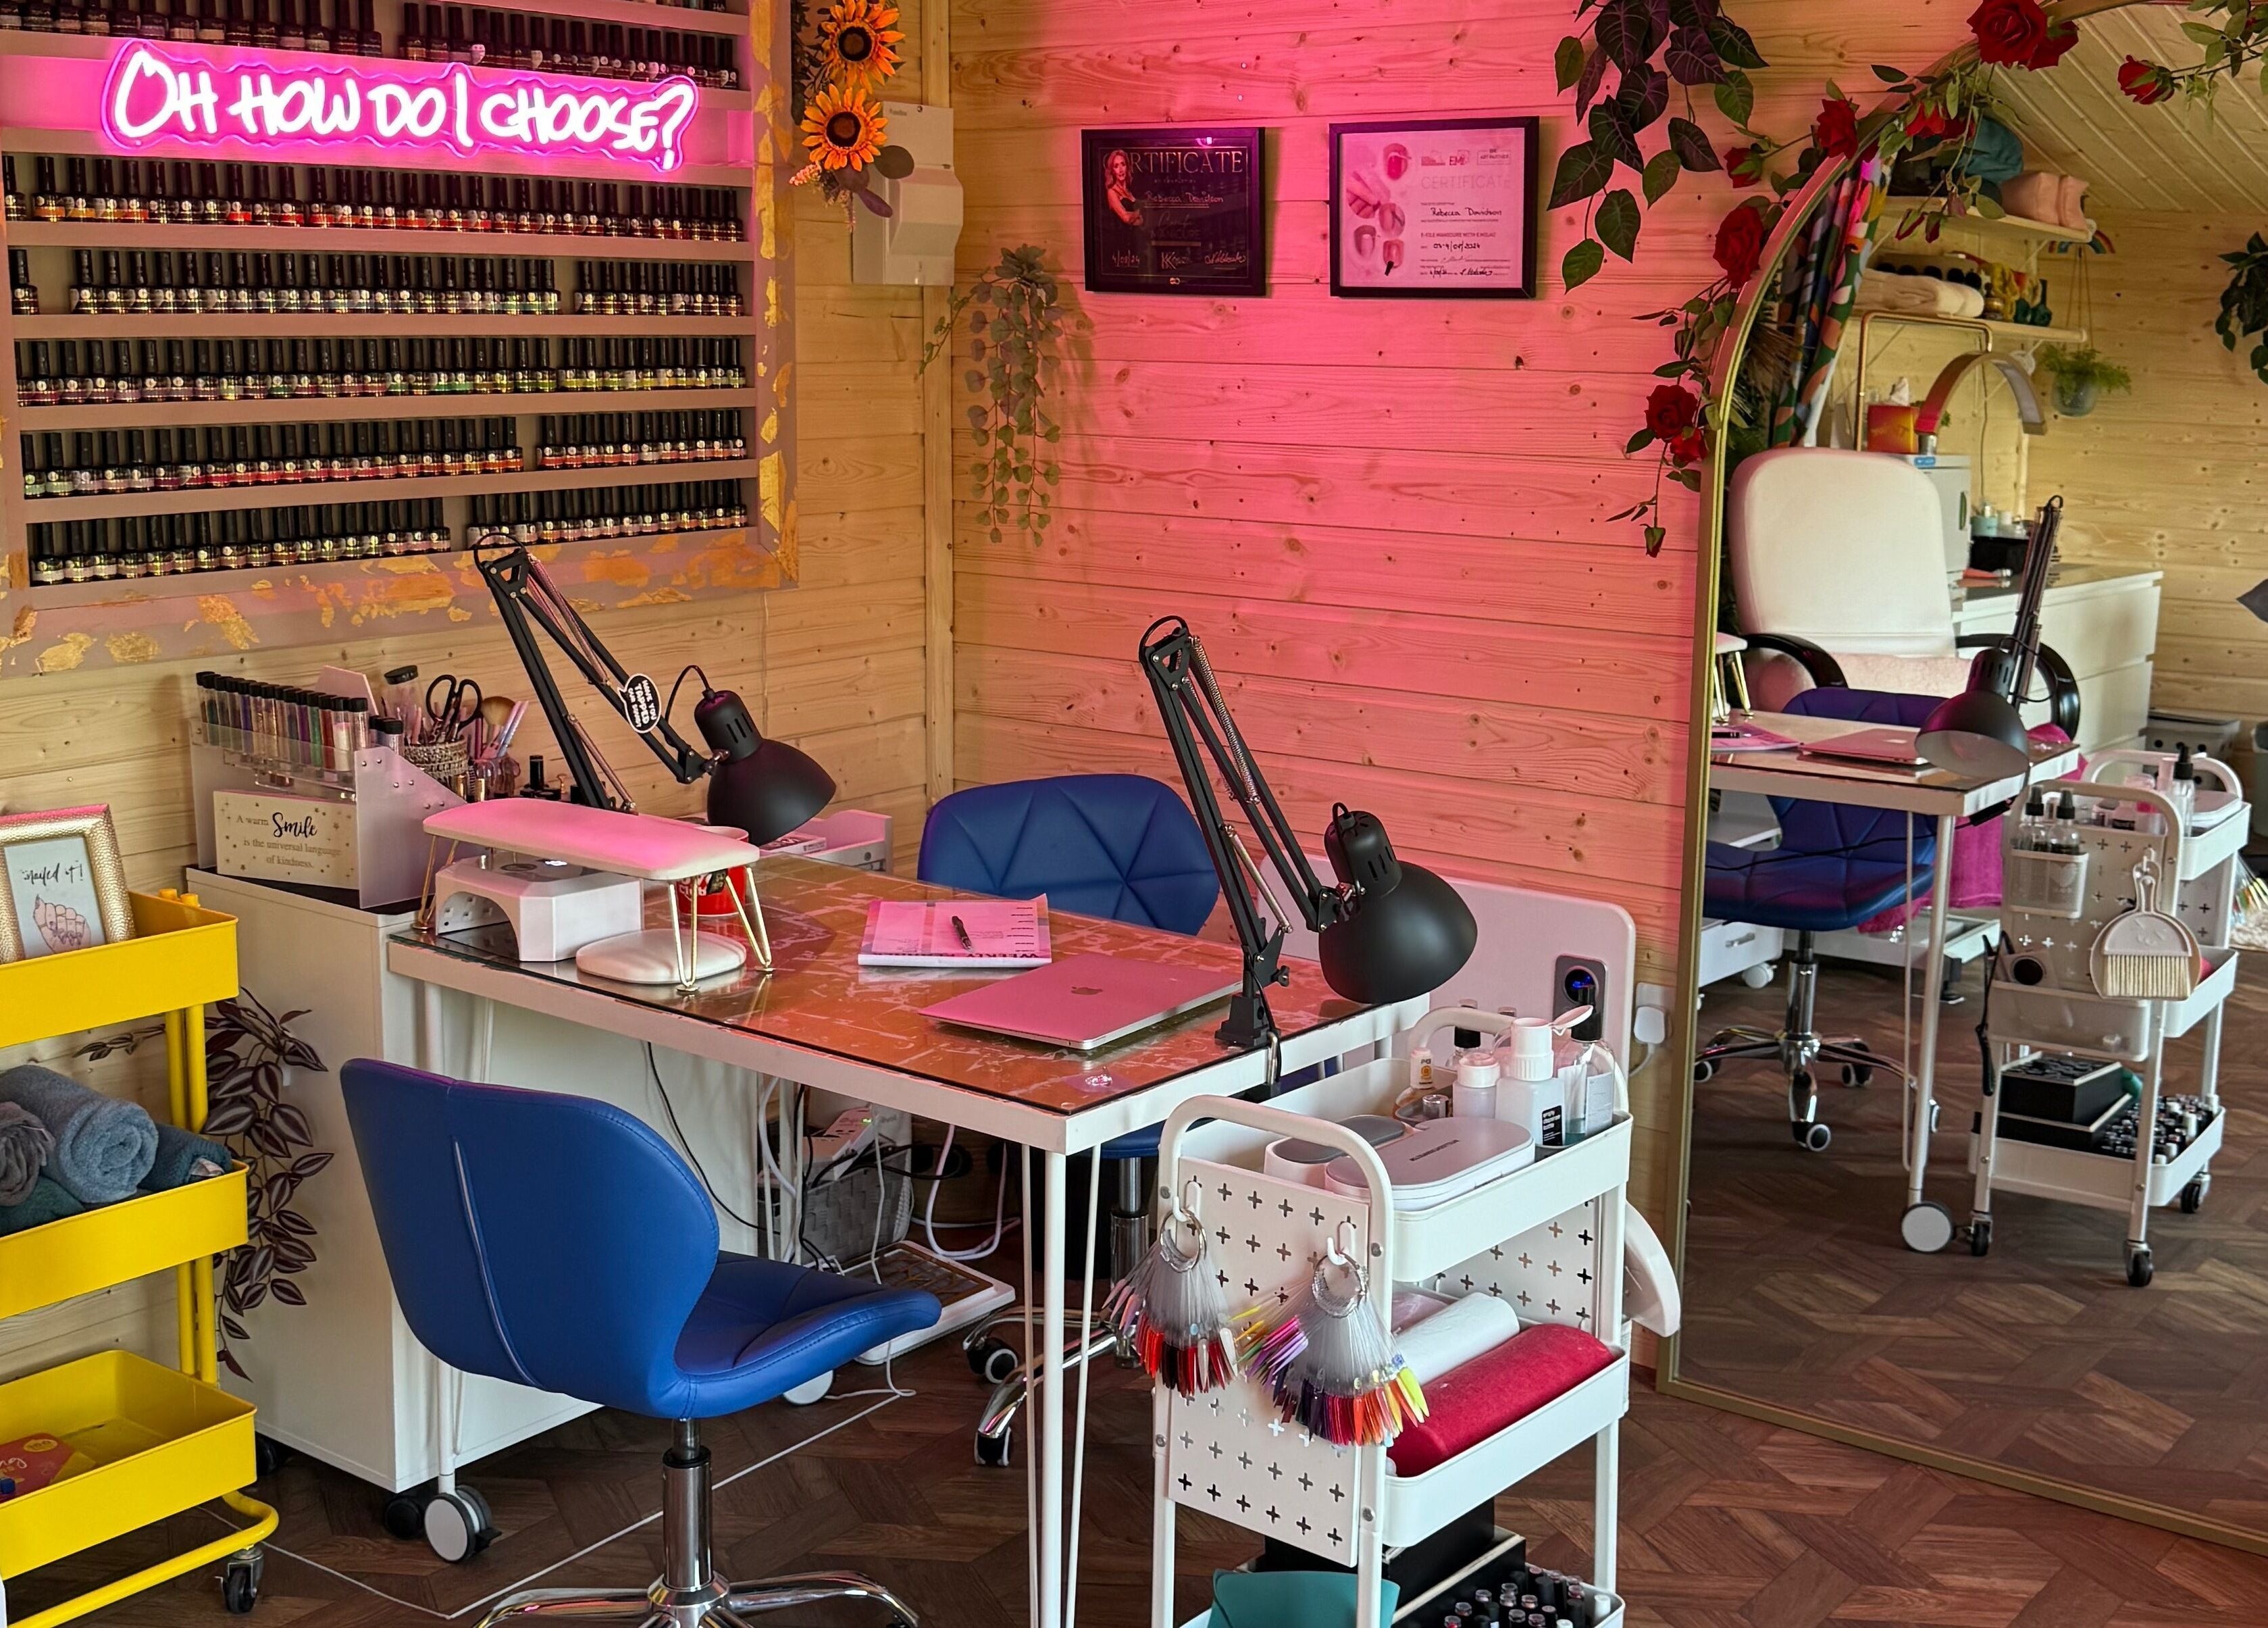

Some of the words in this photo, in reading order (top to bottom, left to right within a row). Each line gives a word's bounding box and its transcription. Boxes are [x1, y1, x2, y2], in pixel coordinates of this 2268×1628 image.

[113, 49, 220, 139] OH
[228, 75, 361, 137] HOW
[369, 88, 447, 140] DO
[453, 71, 475, 148] I
[479, 83, 698, 172] CHOOSE?
[1420, 174, 1512, 189] CERTIFICATE
[634, 683, 650, 724] TAPPED
[648, 703, 657, 720] YOU
[236, 815, 244, 823] A
[246, 817, 269, 826] warm
[272, 812, 318, 838] Smile
[244, 838, 251, 846] is
[253, 838, 265, 848] the
[266, 841, 303, 853] universal
[305, 843, 342, 857] language
[266, 856, 275, 864] of
